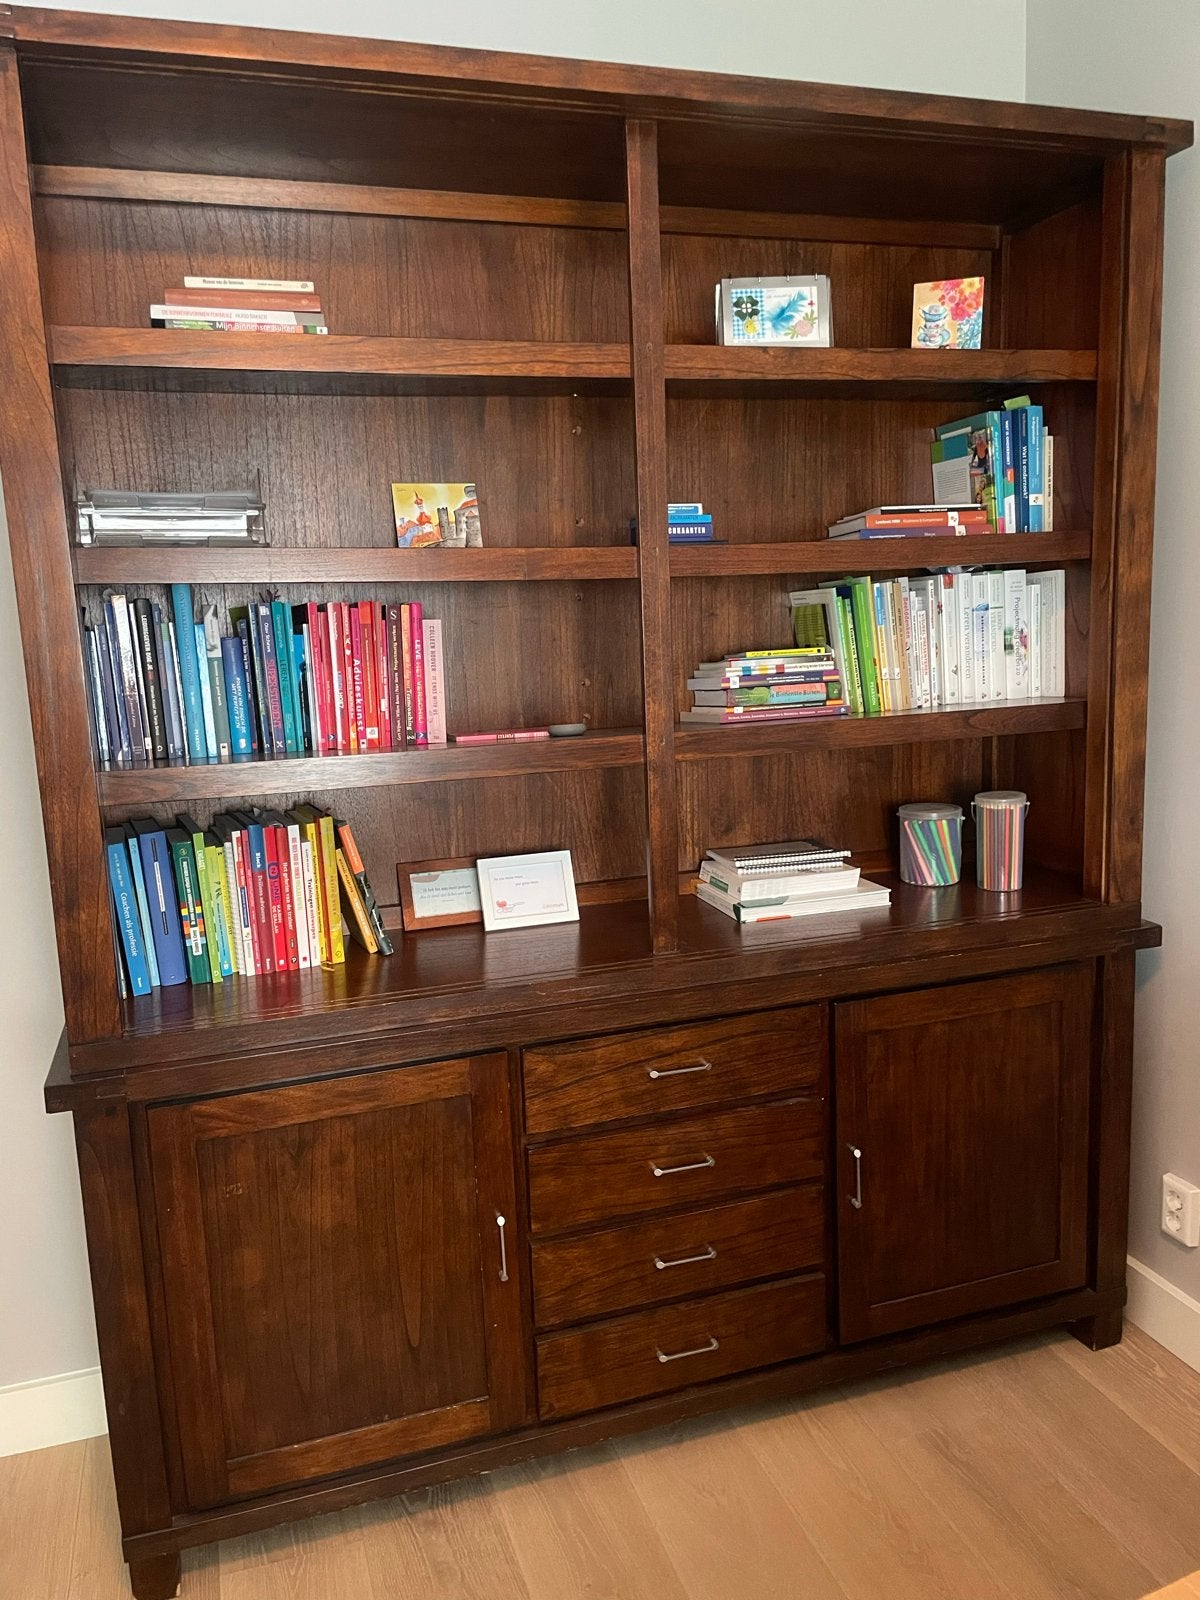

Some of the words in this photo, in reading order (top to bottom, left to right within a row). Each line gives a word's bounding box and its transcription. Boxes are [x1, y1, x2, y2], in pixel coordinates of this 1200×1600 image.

[215, 321, 232, 331] Mijn
[234, 322, 271, 331] Binnenste
[272, 324, 295, 332] Buiten
[140, 614, 150, 651] LEIDINGGEVEN
[902, 597, 910, 638] Beelddenken
[1012, 597, 1022, 639] Projectmatig
[964, 632, 972, 678] veranderen
[279, 659, 288, 682] LEREN
[266, 658, 282, 729] SUPERSTUDENT
[353, 658, 364, 731] Advieskunst
[404, 689, 413, 730] Teamcoaching
[196, 849, 205, 870] ENGAGE!
[282, 872, 290, 892] geheim
[306, 878, 314, 908] Trainingen
[119, 891, 131, 919] Coachen
[125, 919, 133, 928] als
[125, 928, 138, 957] professie
